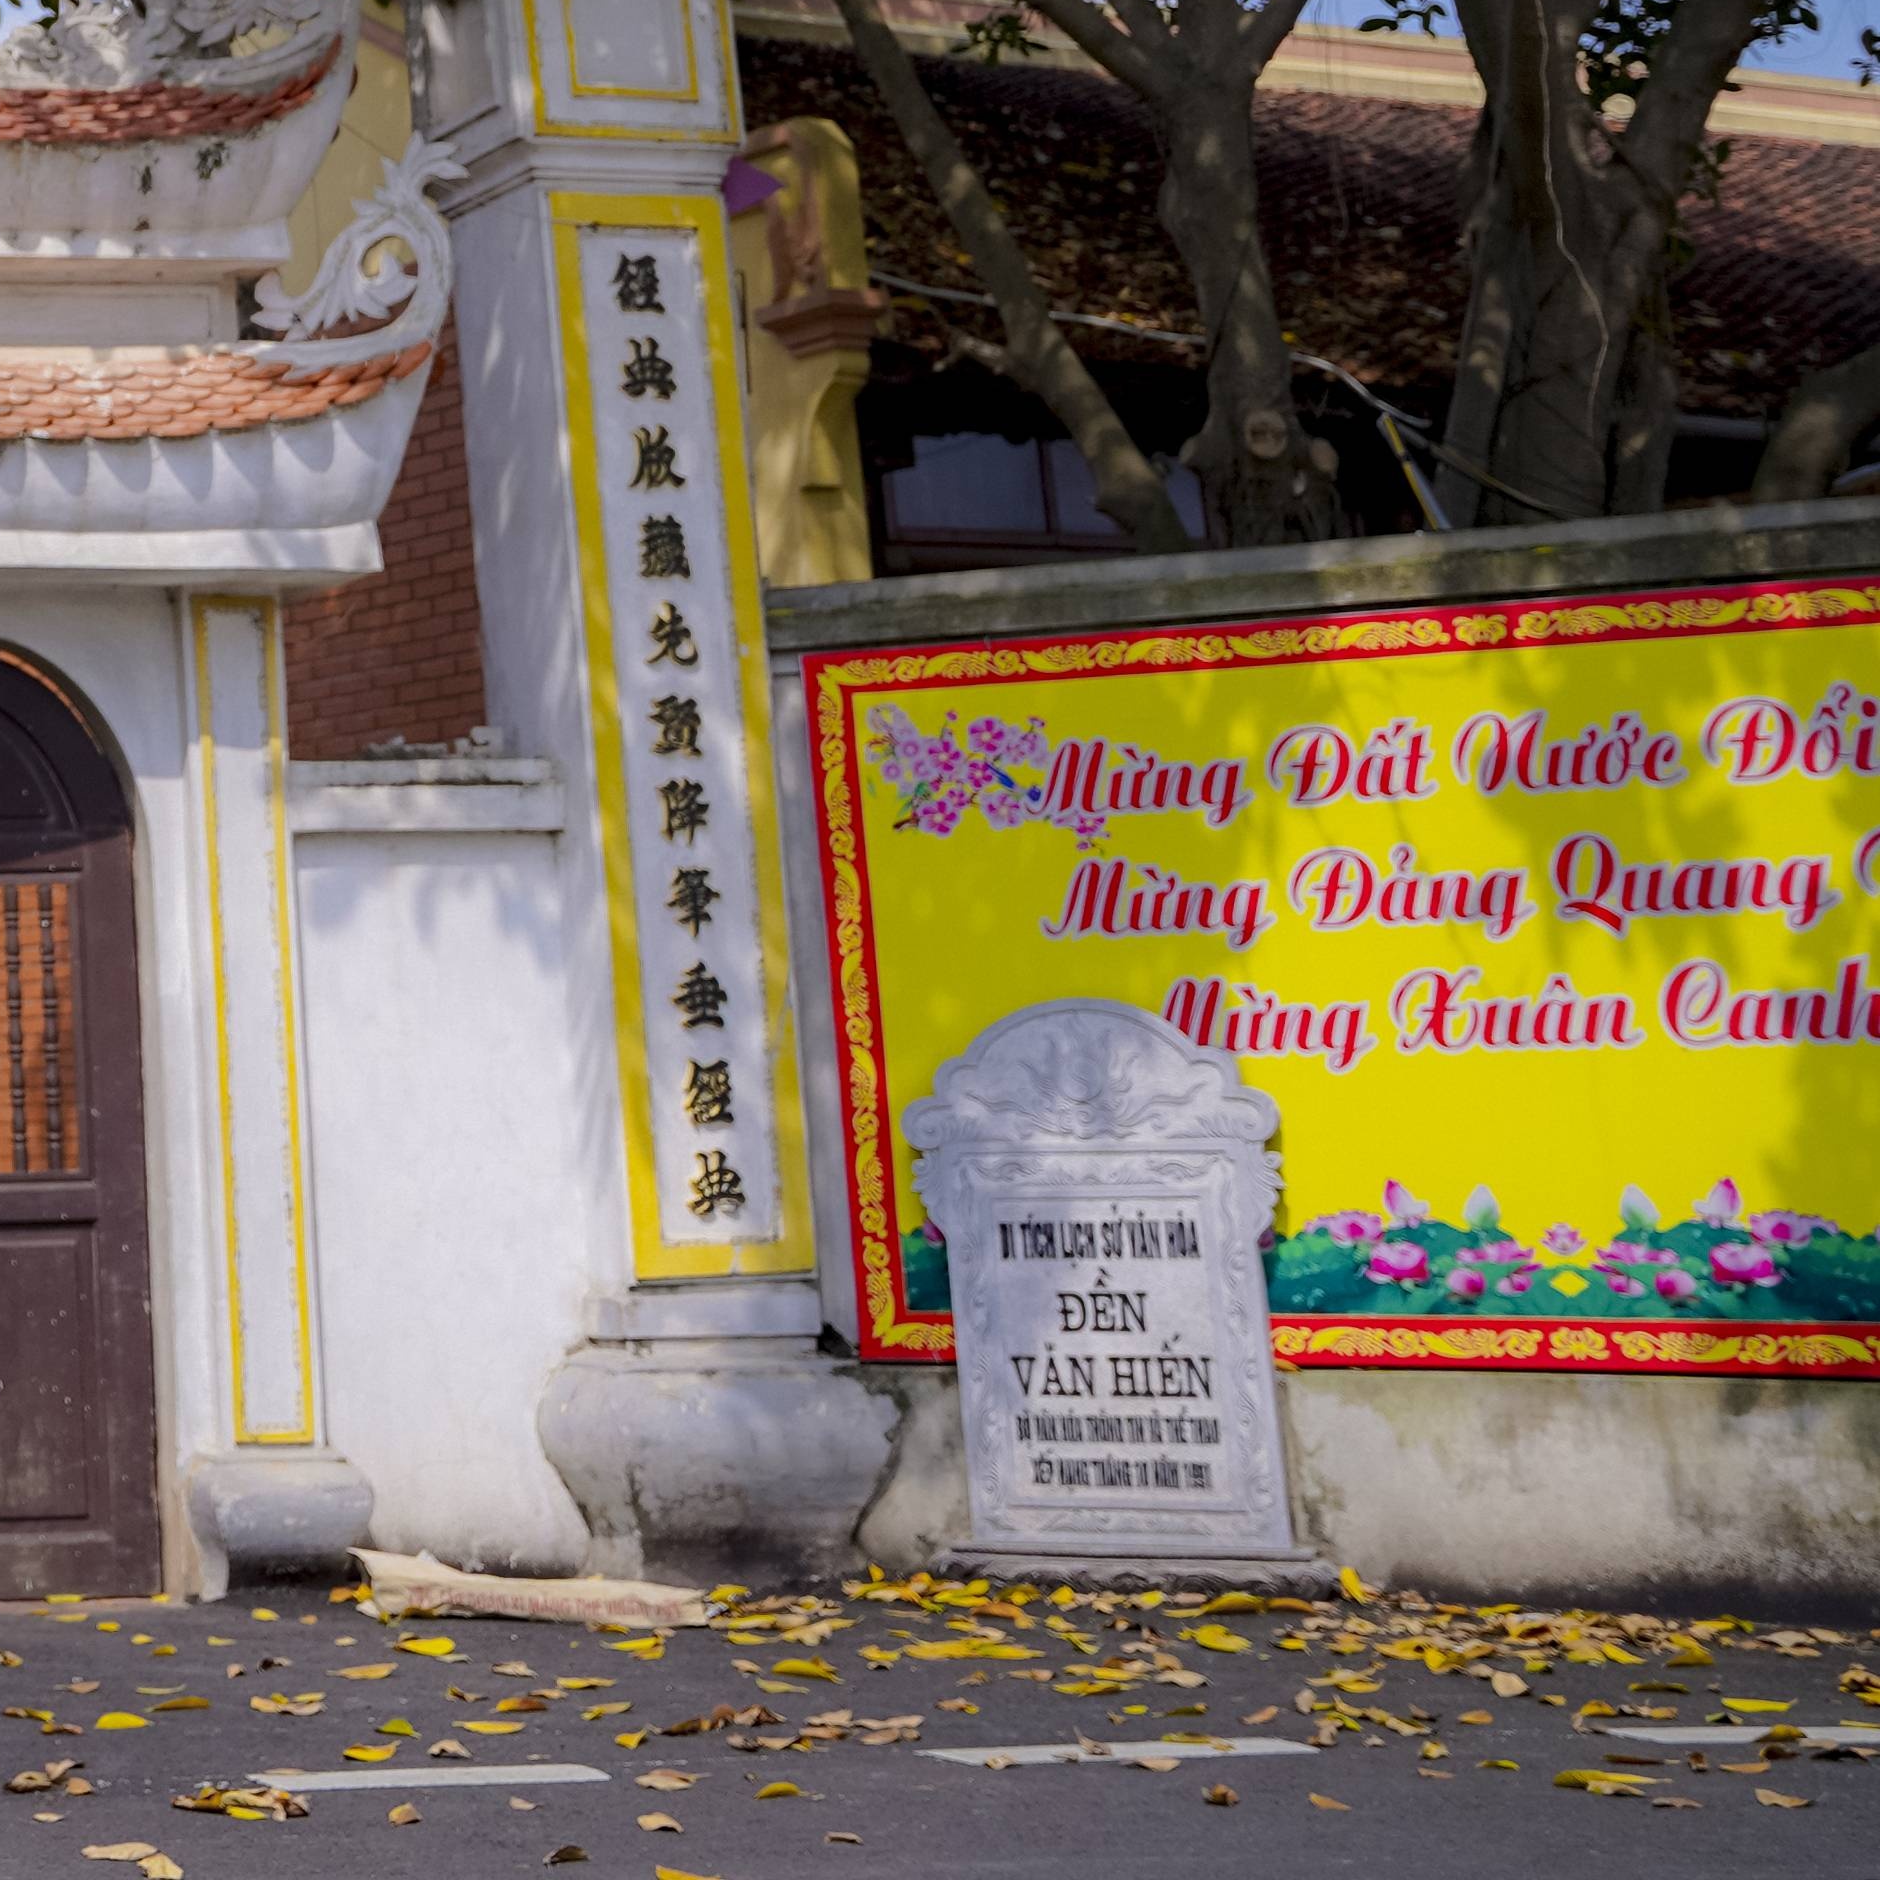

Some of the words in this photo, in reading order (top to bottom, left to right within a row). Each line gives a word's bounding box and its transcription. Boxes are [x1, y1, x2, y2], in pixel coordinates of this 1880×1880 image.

[1023, 738, 1252, 825] Mừng
[1269, 719, 1436, 804] Đất
[1454, 710, 1685, 794] Nước
[1704, 682, 1880, 784] Đổi
[1042, 860, 1274, 949] Mừng
[1291, 844, 1535, 940] Đảng
[1553, 833, 1839, 935] Quang
[1164, 978, 1376, 1071] Mừng
[1391, 968, 1644, 1053] Xuân
[1659, 957, 1880, 1047] Canh
[1056, 1267, 1148, 1333] ĐỀN
[1010, 1340, 1096, 1398] VĂN
[1107, 1331, 1213, 1400] HIẾN
